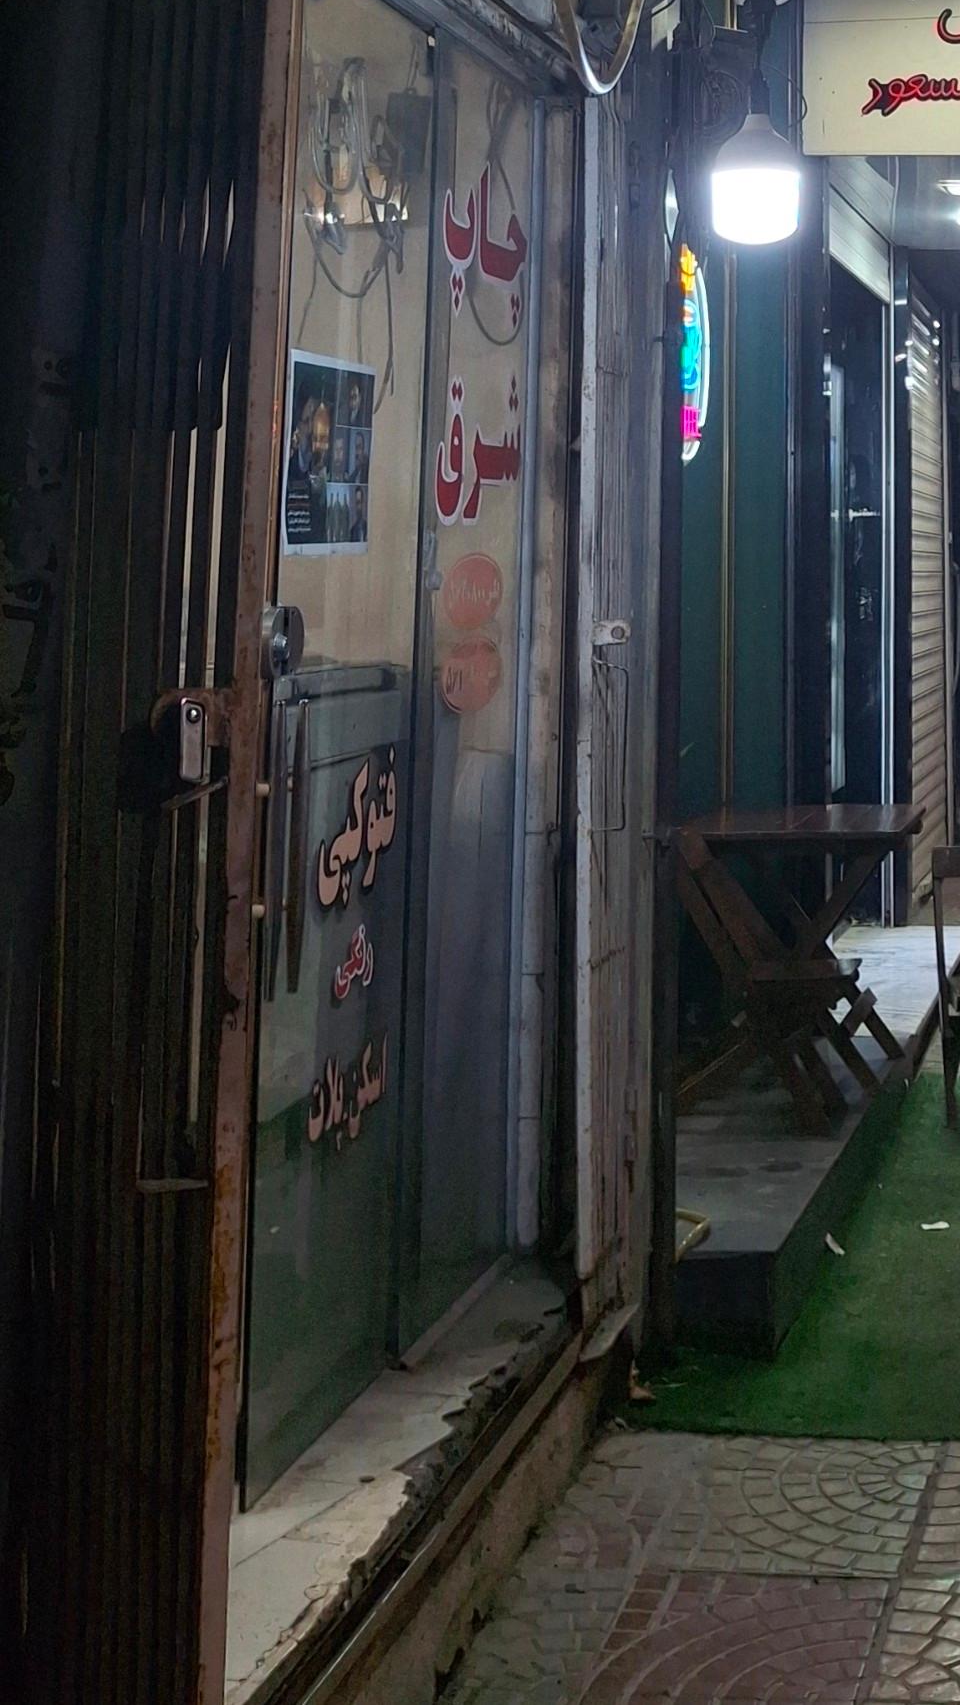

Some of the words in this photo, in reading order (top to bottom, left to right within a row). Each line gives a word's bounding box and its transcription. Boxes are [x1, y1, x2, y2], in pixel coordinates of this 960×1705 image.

[443, 161, 528, 329] چاپ
[435, 374, 522, 526] شرق
[318, 743, 397, 908] فتوکپی
